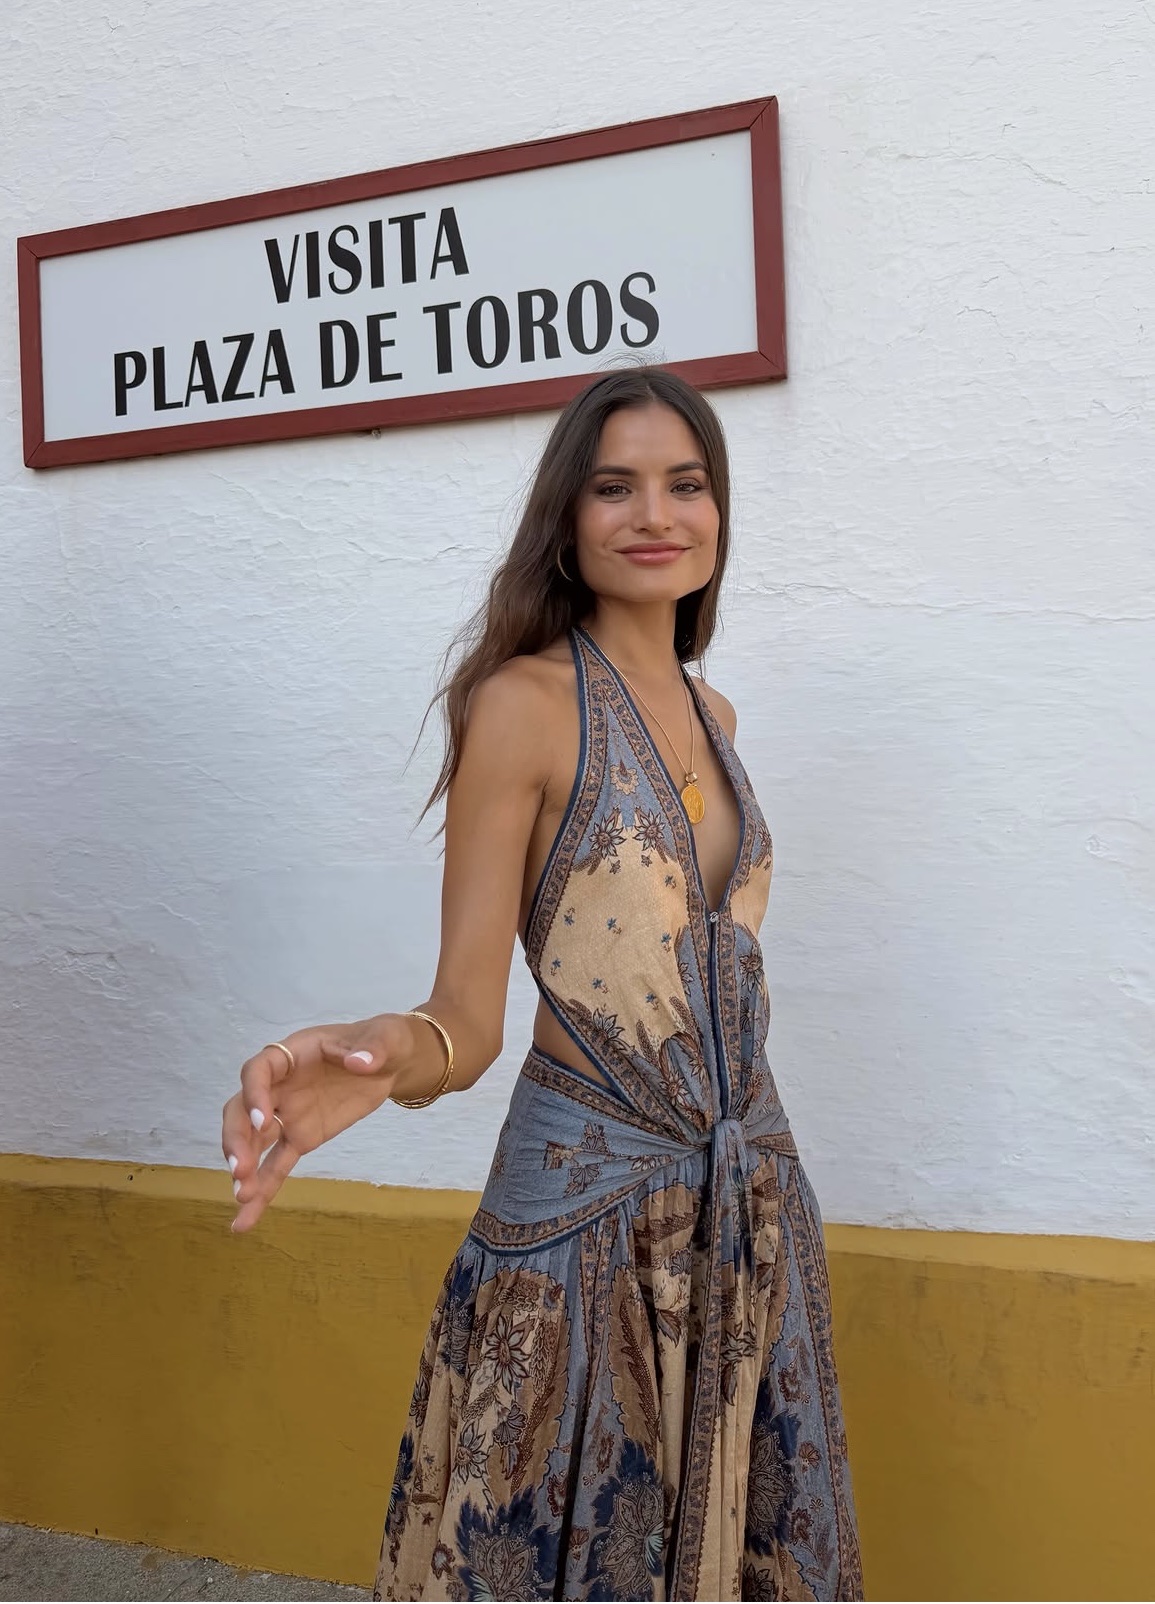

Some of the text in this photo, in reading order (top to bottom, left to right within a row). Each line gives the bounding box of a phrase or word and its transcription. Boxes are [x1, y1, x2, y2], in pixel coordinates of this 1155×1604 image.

[264, 206, 470, 304] VISITA
[113, 271, 660, 417] PLAZA DE TOROS
